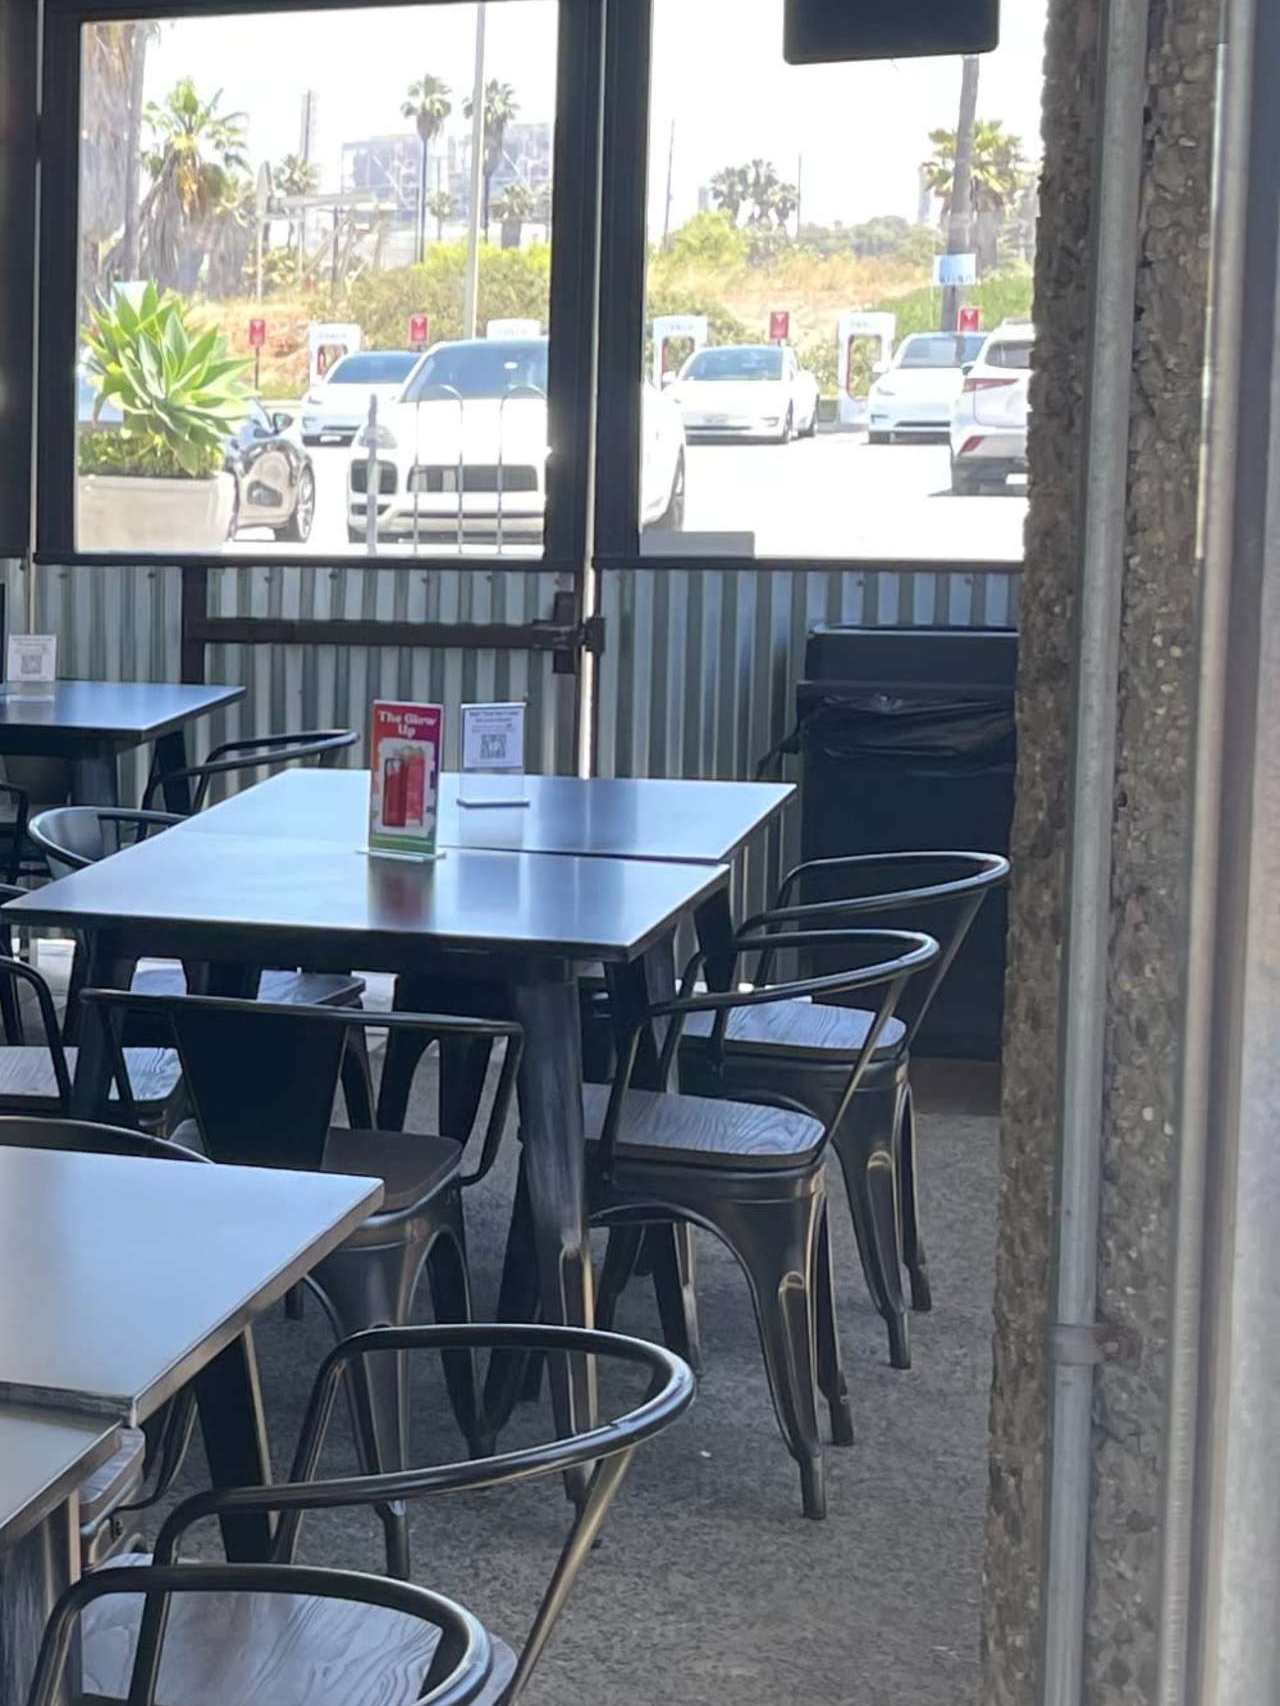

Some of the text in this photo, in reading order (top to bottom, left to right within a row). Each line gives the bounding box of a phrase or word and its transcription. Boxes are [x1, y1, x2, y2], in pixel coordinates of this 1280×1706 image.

[377, 710, 437, 726] The Glow
[398, 724, 416, 738] Up
